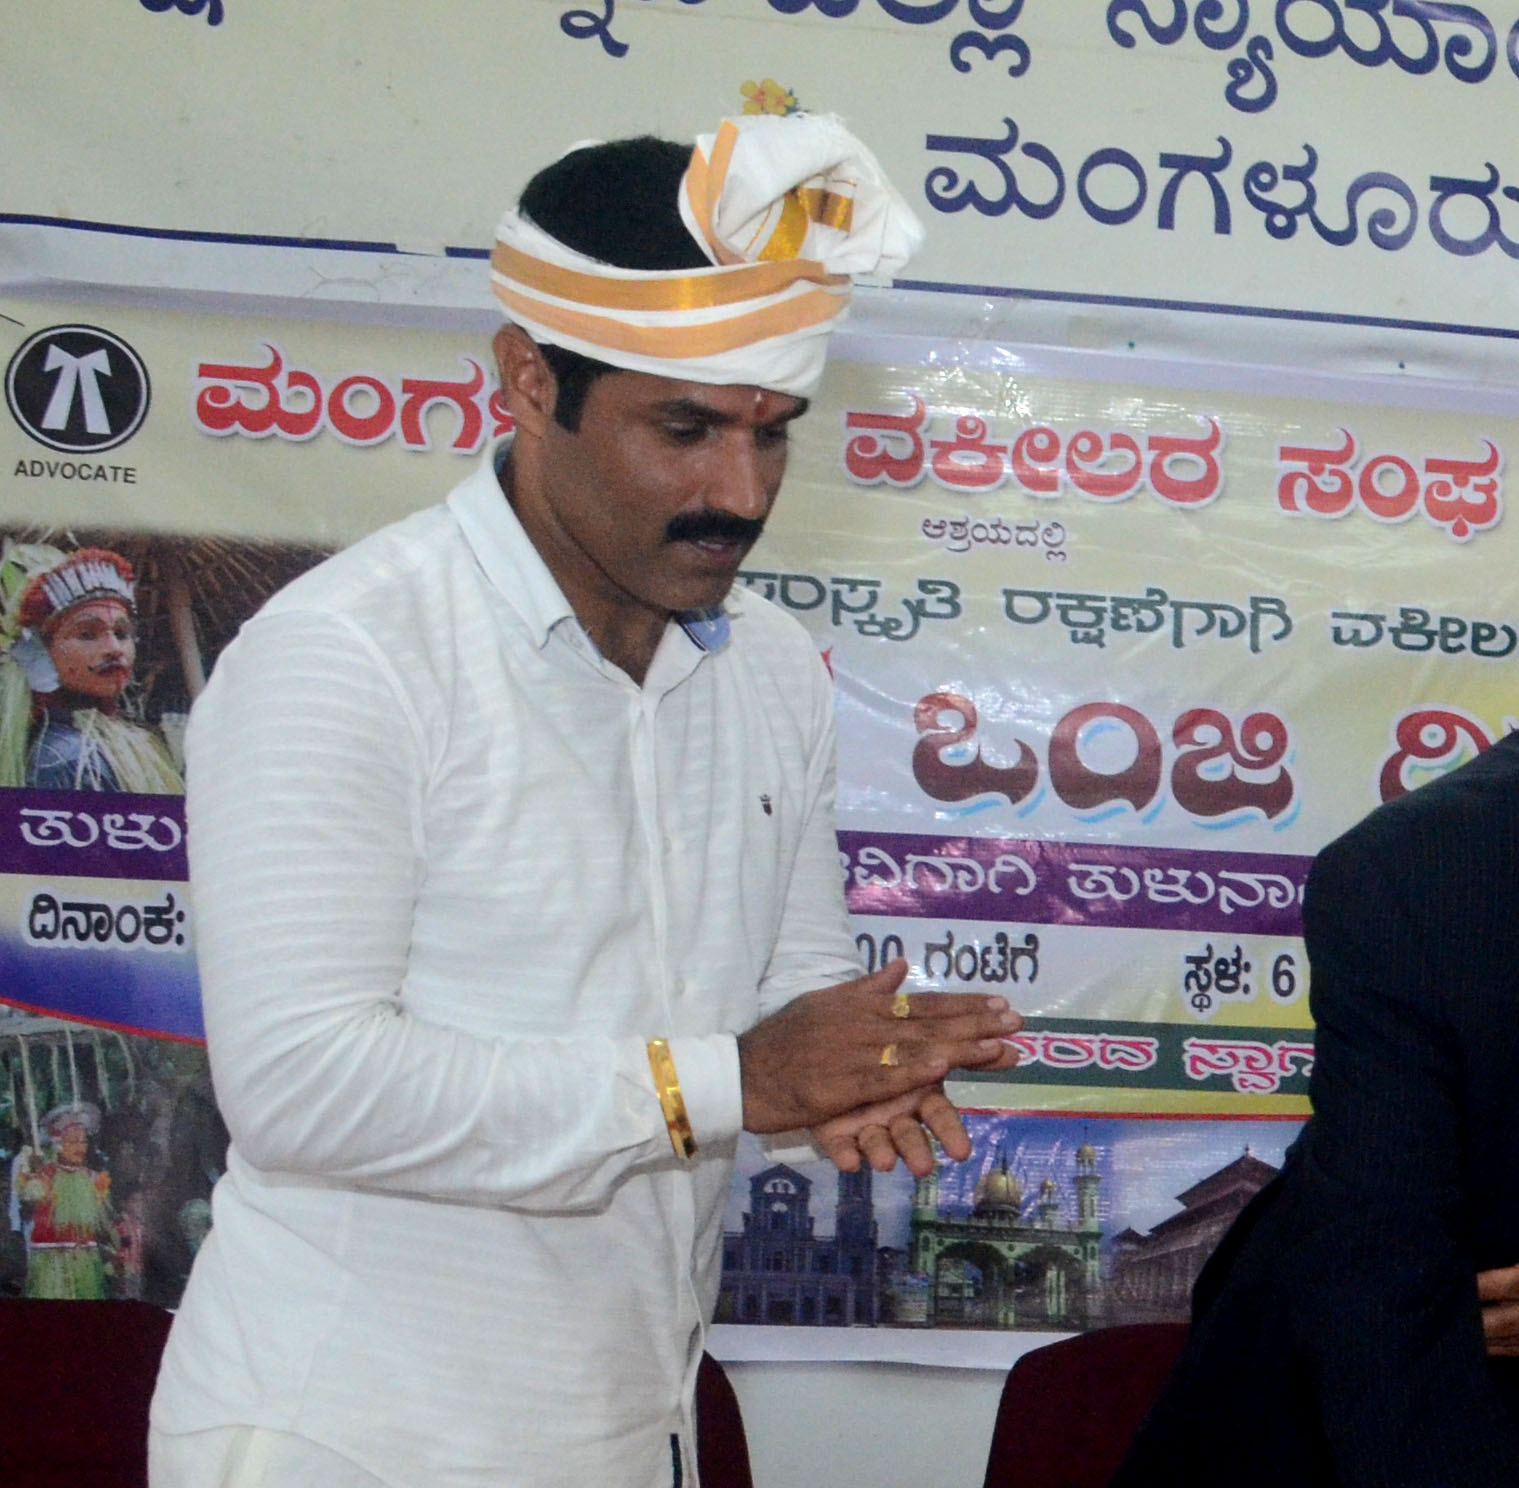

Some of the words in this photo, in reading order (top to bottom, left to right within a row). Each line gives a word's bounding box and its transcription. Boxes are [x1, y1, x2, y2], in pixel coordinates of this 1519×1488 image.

[14, 459, 137, 485] ADVOCATE
[196, 343, 516, 449] ಮಂಗ
[845, 391, 1222, 504] ವಕೀಲರ
[1278, 427, 1499, 537] ಸಂಘ
[922, 515, 1066, 561] ಆಶ್ರಯದಲ್ಲಿ
[1002, 587, 1293, 654] ರಕ್ಷಣೆಗಾಗಿ
[912, 692, 1294, 820] ಒಂಜಿ
[19, 807, 187, 851] ತುಳು
[840, 847, 1038, 896] ವಿಗಾಗಿ
[1068, 863, 1305, 914] ತುಳುನಾ
[29, 893, 185, 946] ದಿನಾಂಕ:
[925, 930, 1040, 984] ಗಂಟೆಗೆ
[1187, 1041, 1316, 1090] ಸ್ವಾಗ
